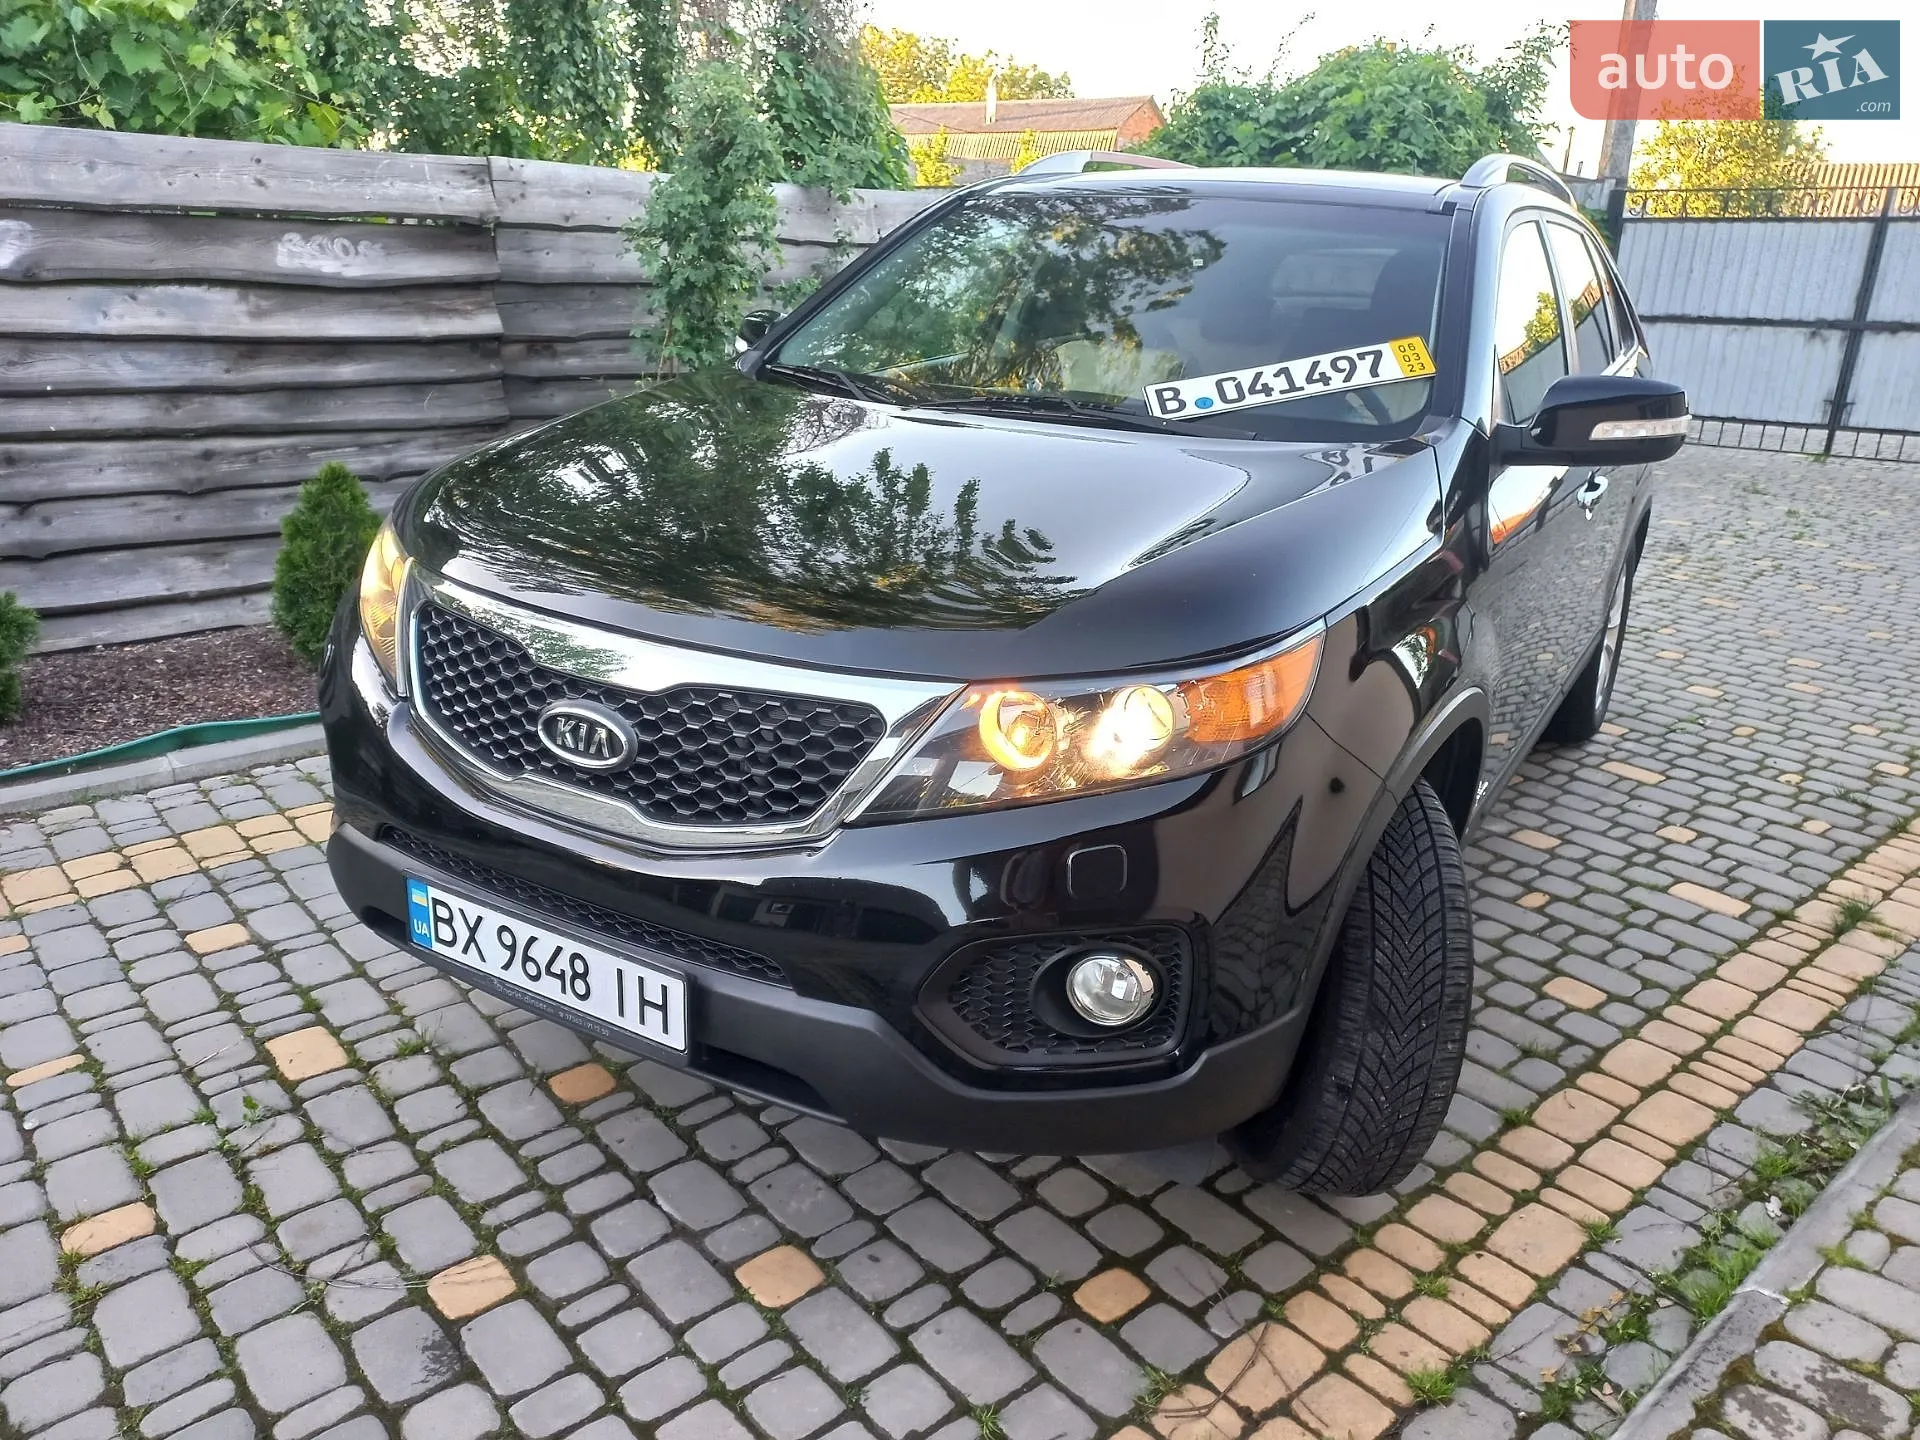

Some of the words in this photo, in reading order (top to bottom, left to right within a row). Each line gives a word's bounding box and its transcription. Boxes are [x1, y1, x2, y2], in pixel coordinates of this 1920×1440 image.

[1398, 343, 1416, 353] 06
[1402, 352, 1421, 363] 03
[1407, 362, 1426, 373] 23
[1154, 386, 1187, 416] B
[1215, 349, 1384, 405] 041497
[556, 717, 610, 758] KIA
[413, 918, 430, 938] UA
[431, 896, 486, 963] BX
[496, 924, 591, 1002] 9648
[616, 967, 669, 1036] IH
